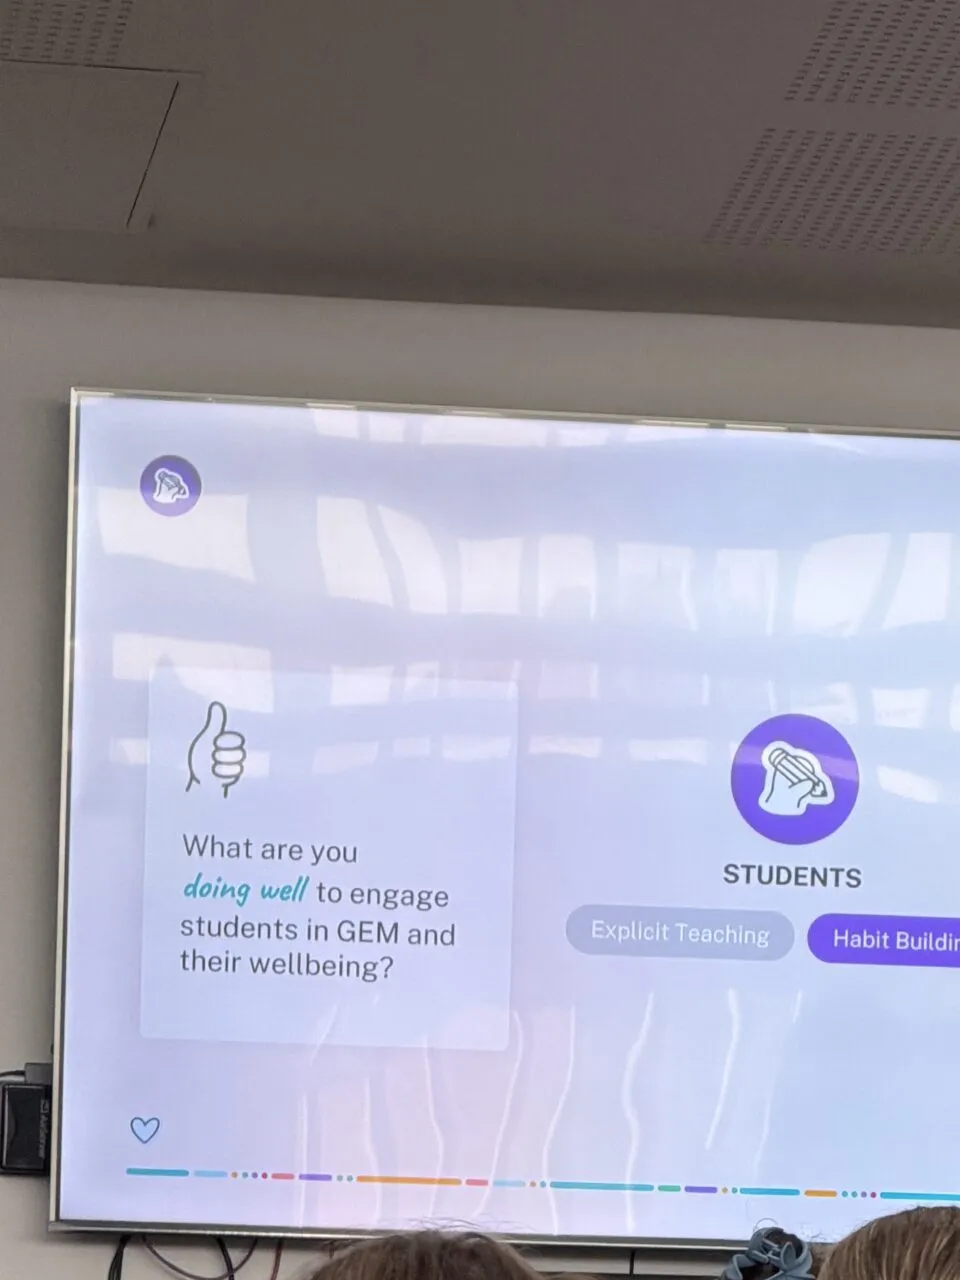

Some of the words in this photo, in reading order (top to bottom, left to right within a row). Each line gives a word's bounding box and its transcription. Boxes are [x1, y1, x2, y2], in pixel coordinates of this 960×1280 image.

[183, 834, 252, 859] What
[261, 842, 303, 861] are
[311, 845, 357, 866] you
[183, 872, 251, 907] doing
[260, 876, 310, 902] well
[316, 882, 342, 903] to
[350, 886, 449, 911] engage
[723, 863, 862, 889] STUDENTS
[180, 915, 298, 940] students
[307, 918, 328, 942] in
[337, 920, 399, 944] GEM
[407, 923, 455, 946] and
[591, 919, 669, 944] Explicit
[676, 923, 770, 949] Teaching
[833, 928, 889, 950] Habit
[180, 949, 241, 974] their
[250, 952, 393, 983] wellbeing?
